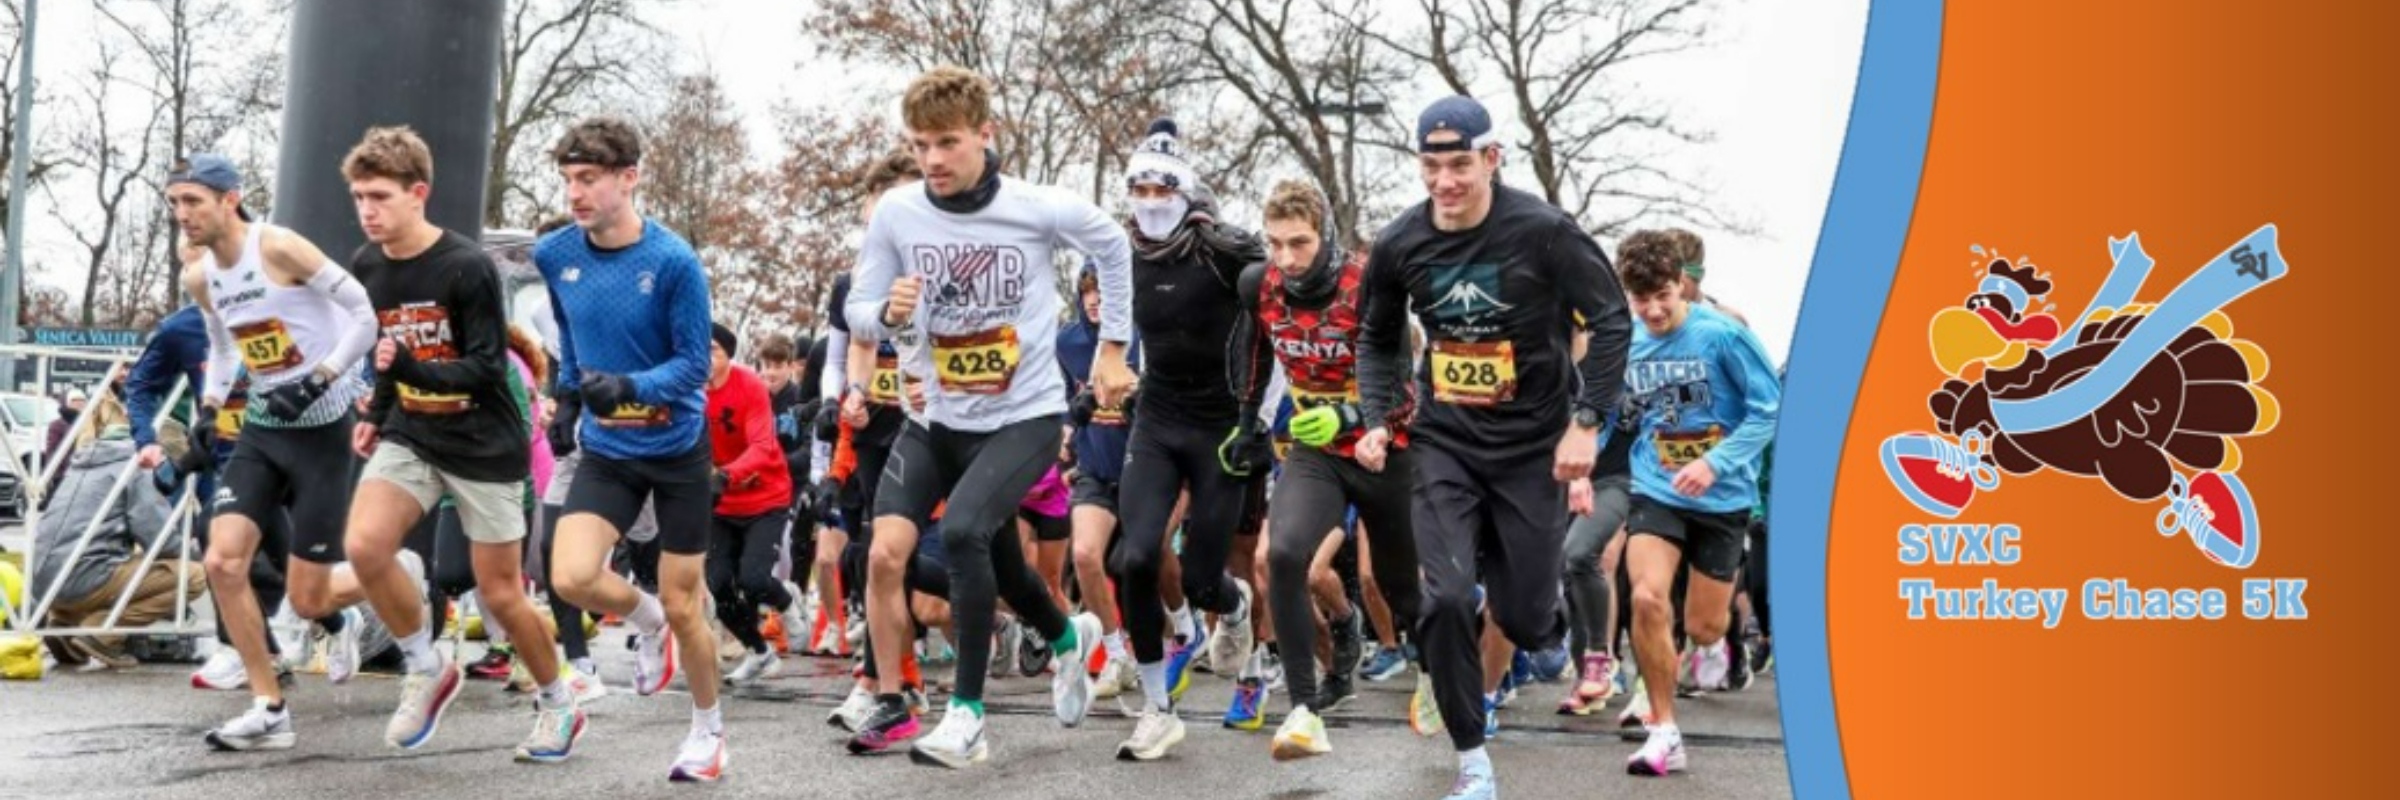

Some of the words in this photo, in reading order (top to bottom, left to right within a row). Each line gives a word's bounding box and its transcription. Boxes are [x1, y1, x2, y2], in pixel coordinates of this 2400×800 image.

[912, 242, 1025, 308] RWB
[34, 327, 87, 346] SENECA
[90, 328, 139, 346] VALLEY
[246, 336, 279, 361] 457
[947, 349, 1006, 376] 428
[1274, 339, 1352, 361] KENYA
[1445, 360, 1498, 386] 628
